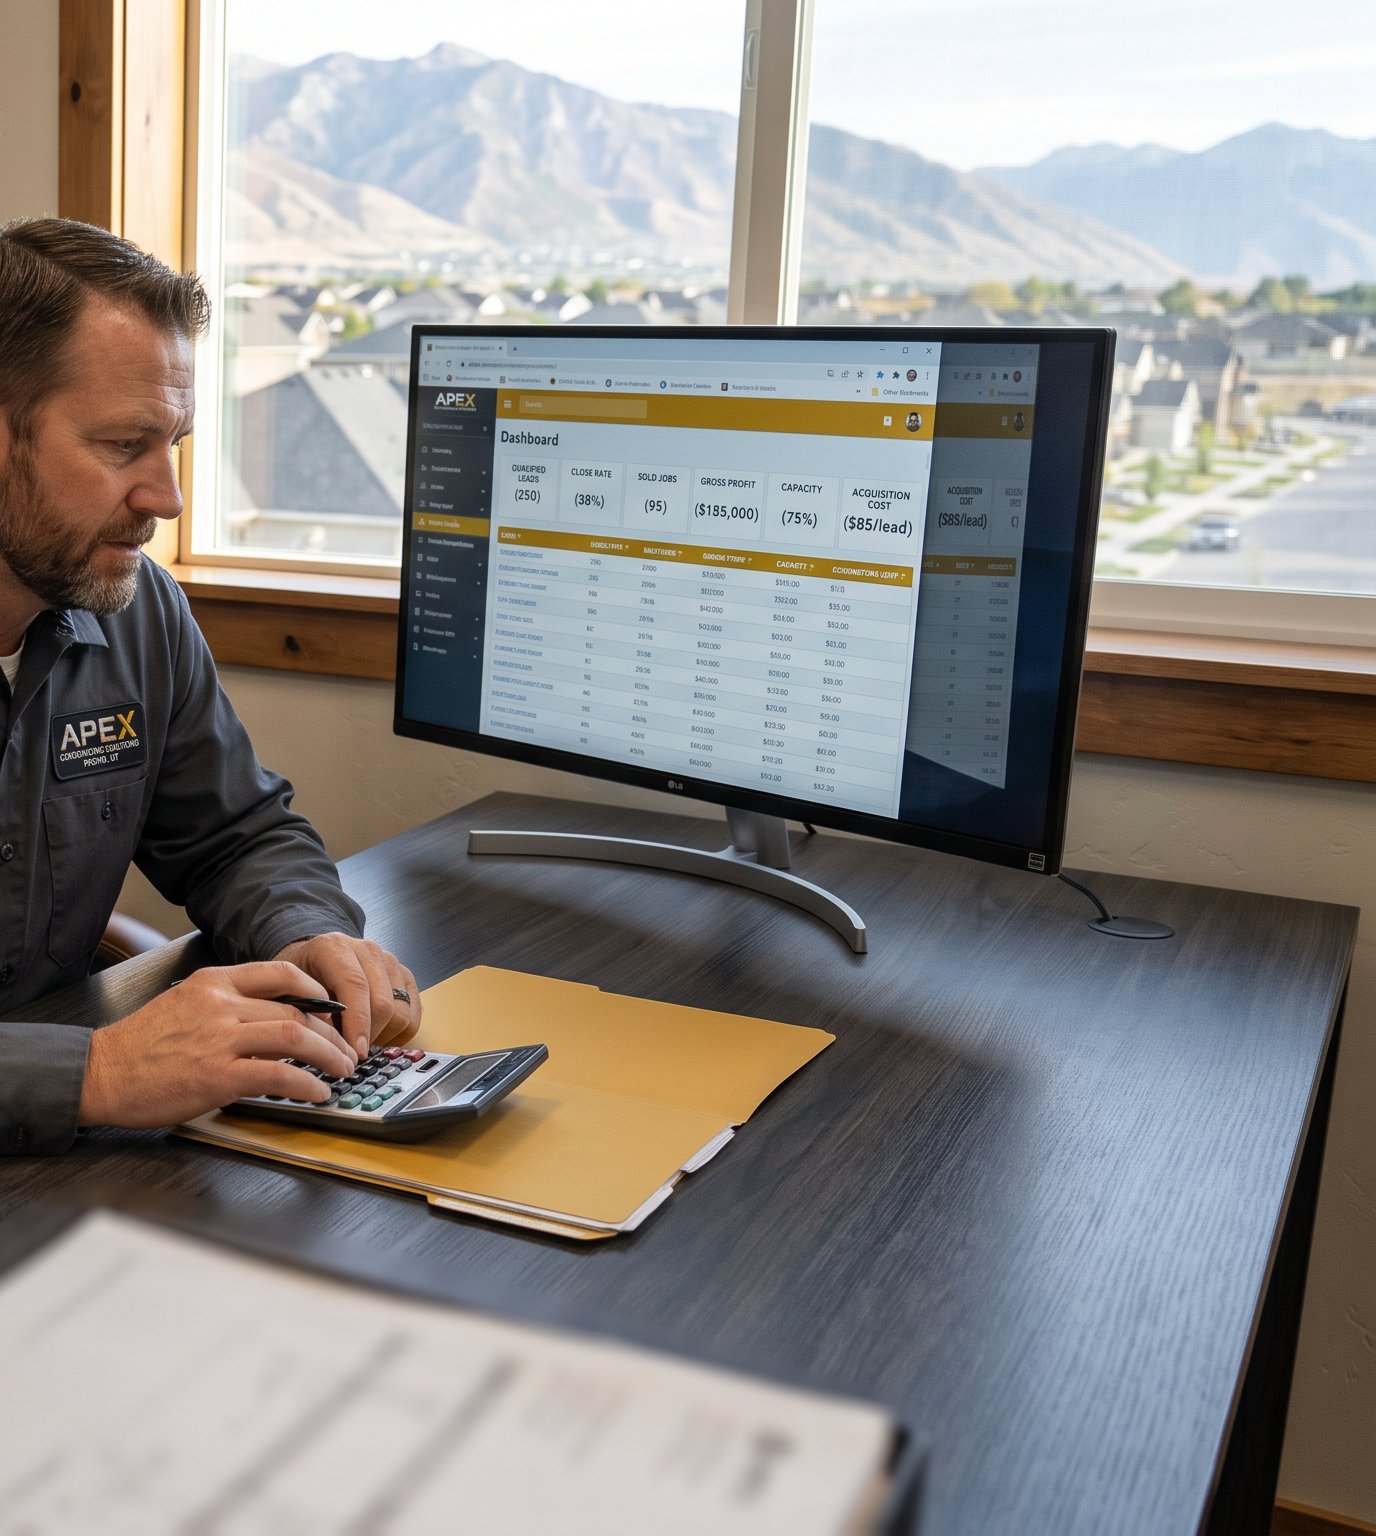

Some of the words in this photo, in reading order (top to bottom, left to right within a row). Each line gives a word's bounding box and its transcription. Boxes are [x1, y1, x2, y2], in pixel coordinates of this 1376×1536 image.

[435, 393, 476, 407] APEX
[501, 431, 559, 446] Dashboard
[571, 468, 593, 477] CLOSE
[594, 470, 612, 478] RATE
[638, 473, 657, 482] SOLD
[658, 475, 677, 483] JOBS
[701, 477, 726, 487] GROSS
[727, 479, 756, 489] PROFIT
[781, 483, 823, 494] CAPACITY
[514, 489, 541, 504] (250)
[574, 493, 605, 509] (38%)
[644, 499, 667, 515] (95)
[694, 503, 759, 523] ($185,000)
[868, 500, 892, 511] COST
[781, 510, 818, 529] (75%)
[843, 515, 913, 538] ($85/lead)
[60, 710, 137, 751] APEX
